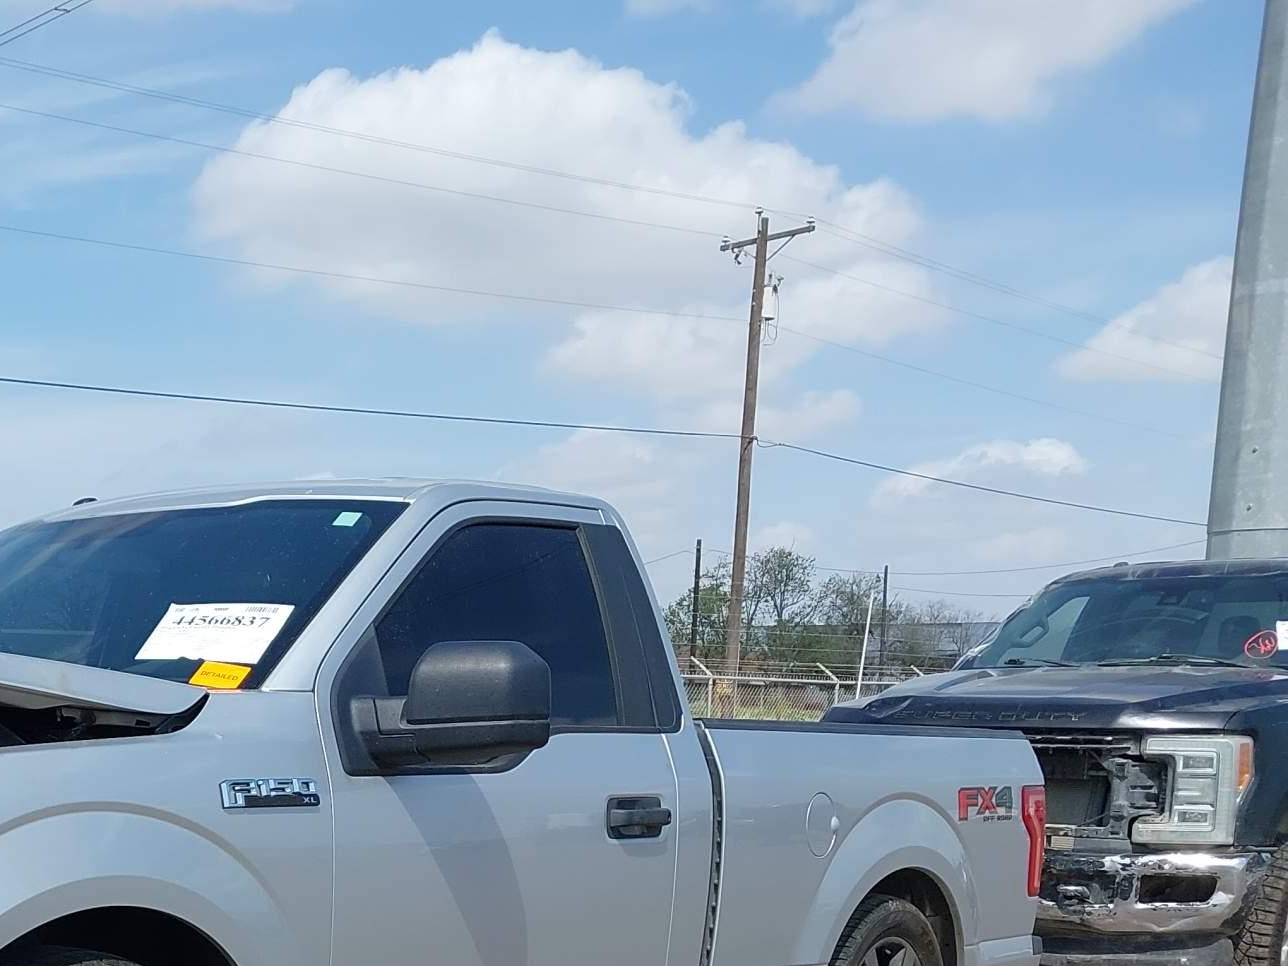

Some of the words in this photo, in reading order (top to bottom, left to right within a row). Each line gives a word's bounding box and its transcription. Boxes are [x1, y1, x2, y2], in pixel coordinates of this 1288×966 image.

[172, 615, 271, 627] 44566837
[200, 670, 239, 681] DETAILED
[895, 710, 992, 721] SUPER
[998, 711, 1087, 721] DUTY
[958, 786, 1013, 821] FX4
